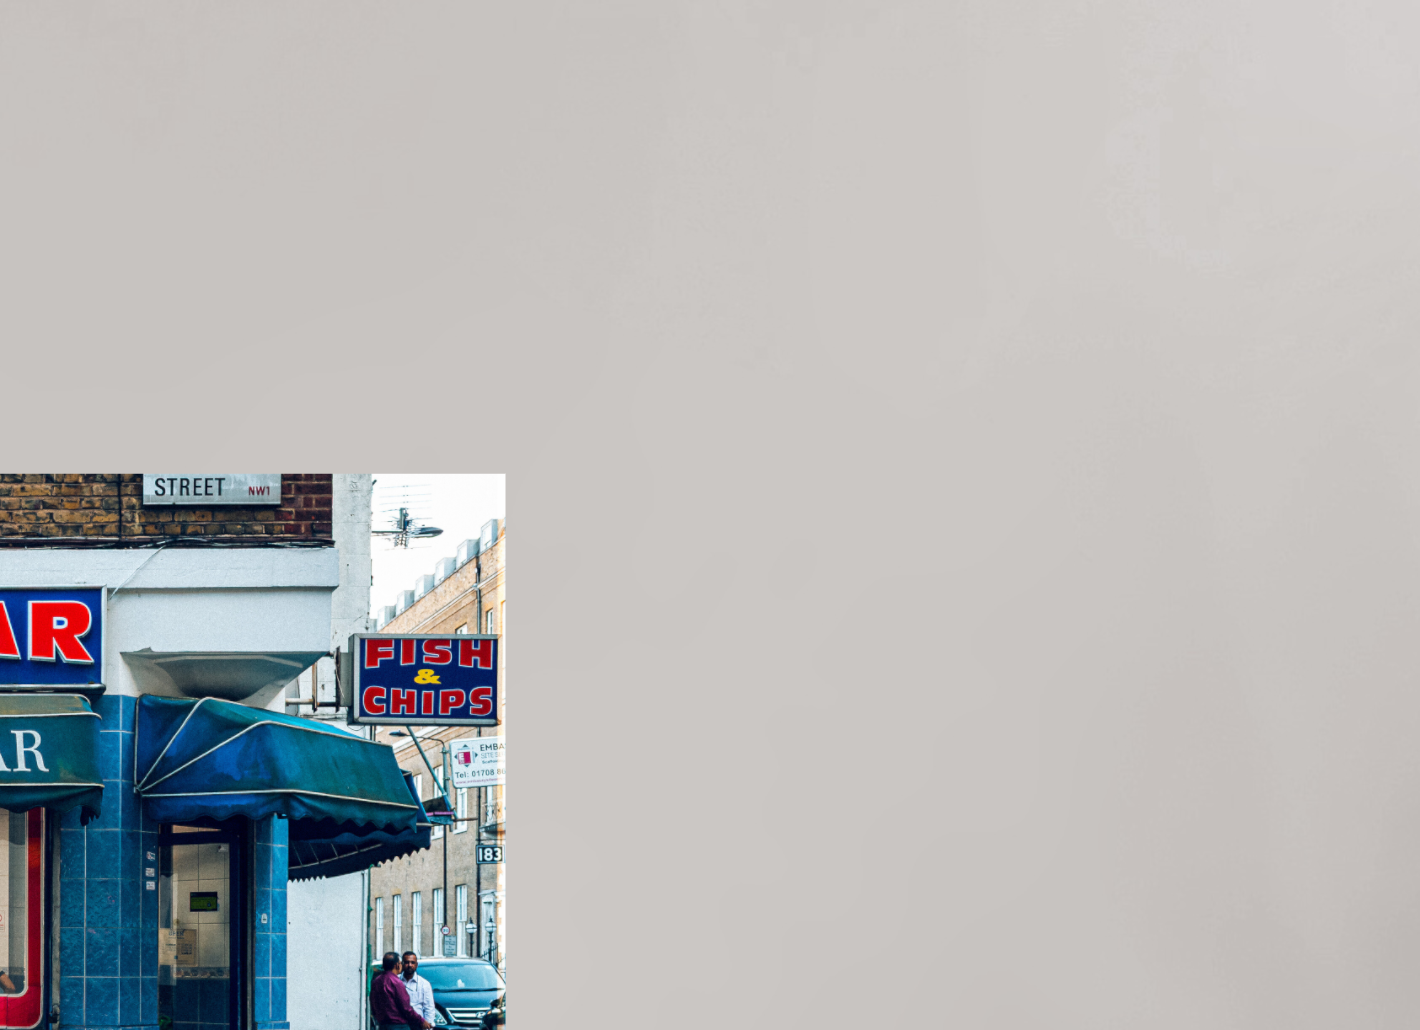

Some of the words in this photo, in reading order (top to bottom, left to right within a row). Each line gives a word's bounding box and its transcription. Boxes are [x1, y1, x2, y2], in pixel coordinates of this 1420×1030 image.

[154, 477, 226, 496] STREET
[248, 485, 270, 496] NW1
[364, 638, 493, 670] FISH
[413, 668, 442, 685] &
[362, 686, 493, 717] CHIPS
[480, 743, 506, 751] EMBA
[455, 771, 469, 779] Tel:
[471, 769, 495, 777] 01708
[478, 847, 502, 862] 183
